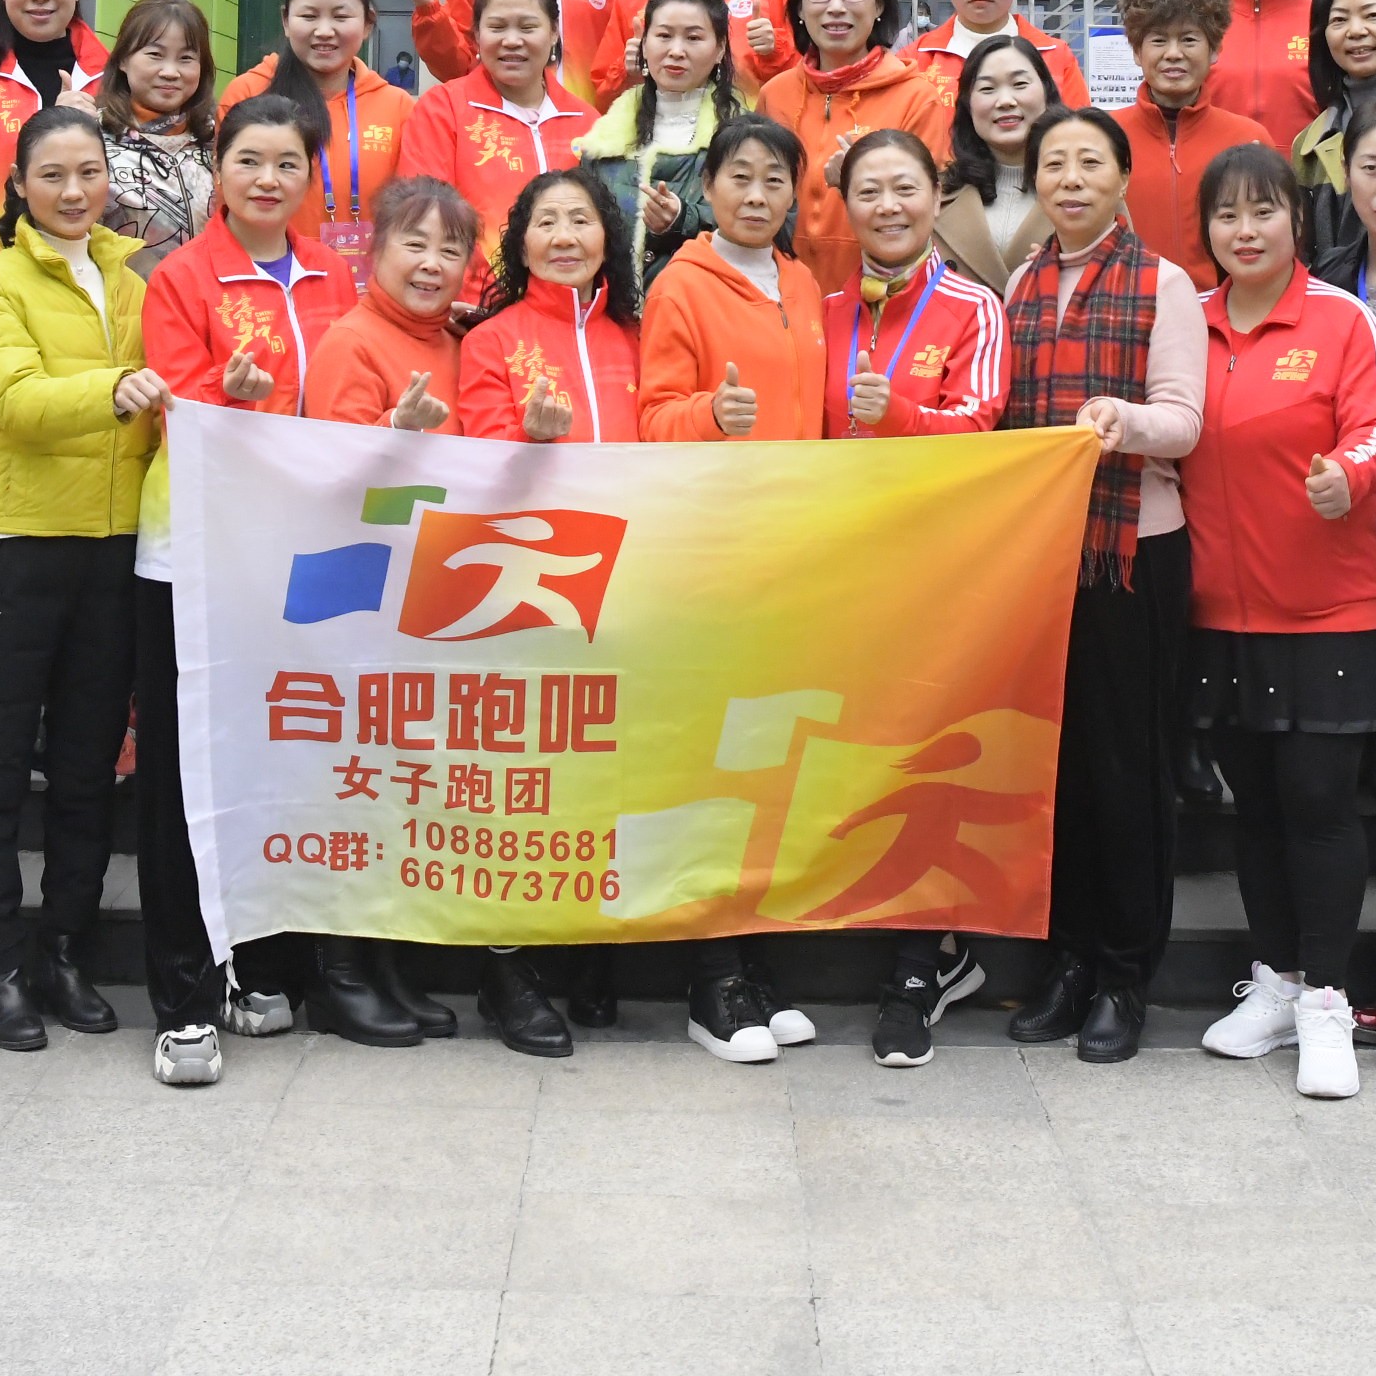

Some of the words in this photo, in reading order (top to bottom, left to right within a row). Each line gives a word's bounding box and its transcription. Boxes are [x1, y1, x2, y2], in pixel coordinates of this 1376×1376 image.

[265, 670, 618, 753] 合肥跑吧
[332, 755, 552, 816] 女子跑团
[402, 818, 618, 862] 108885681
[400, 857, 621, 903] 661073706
